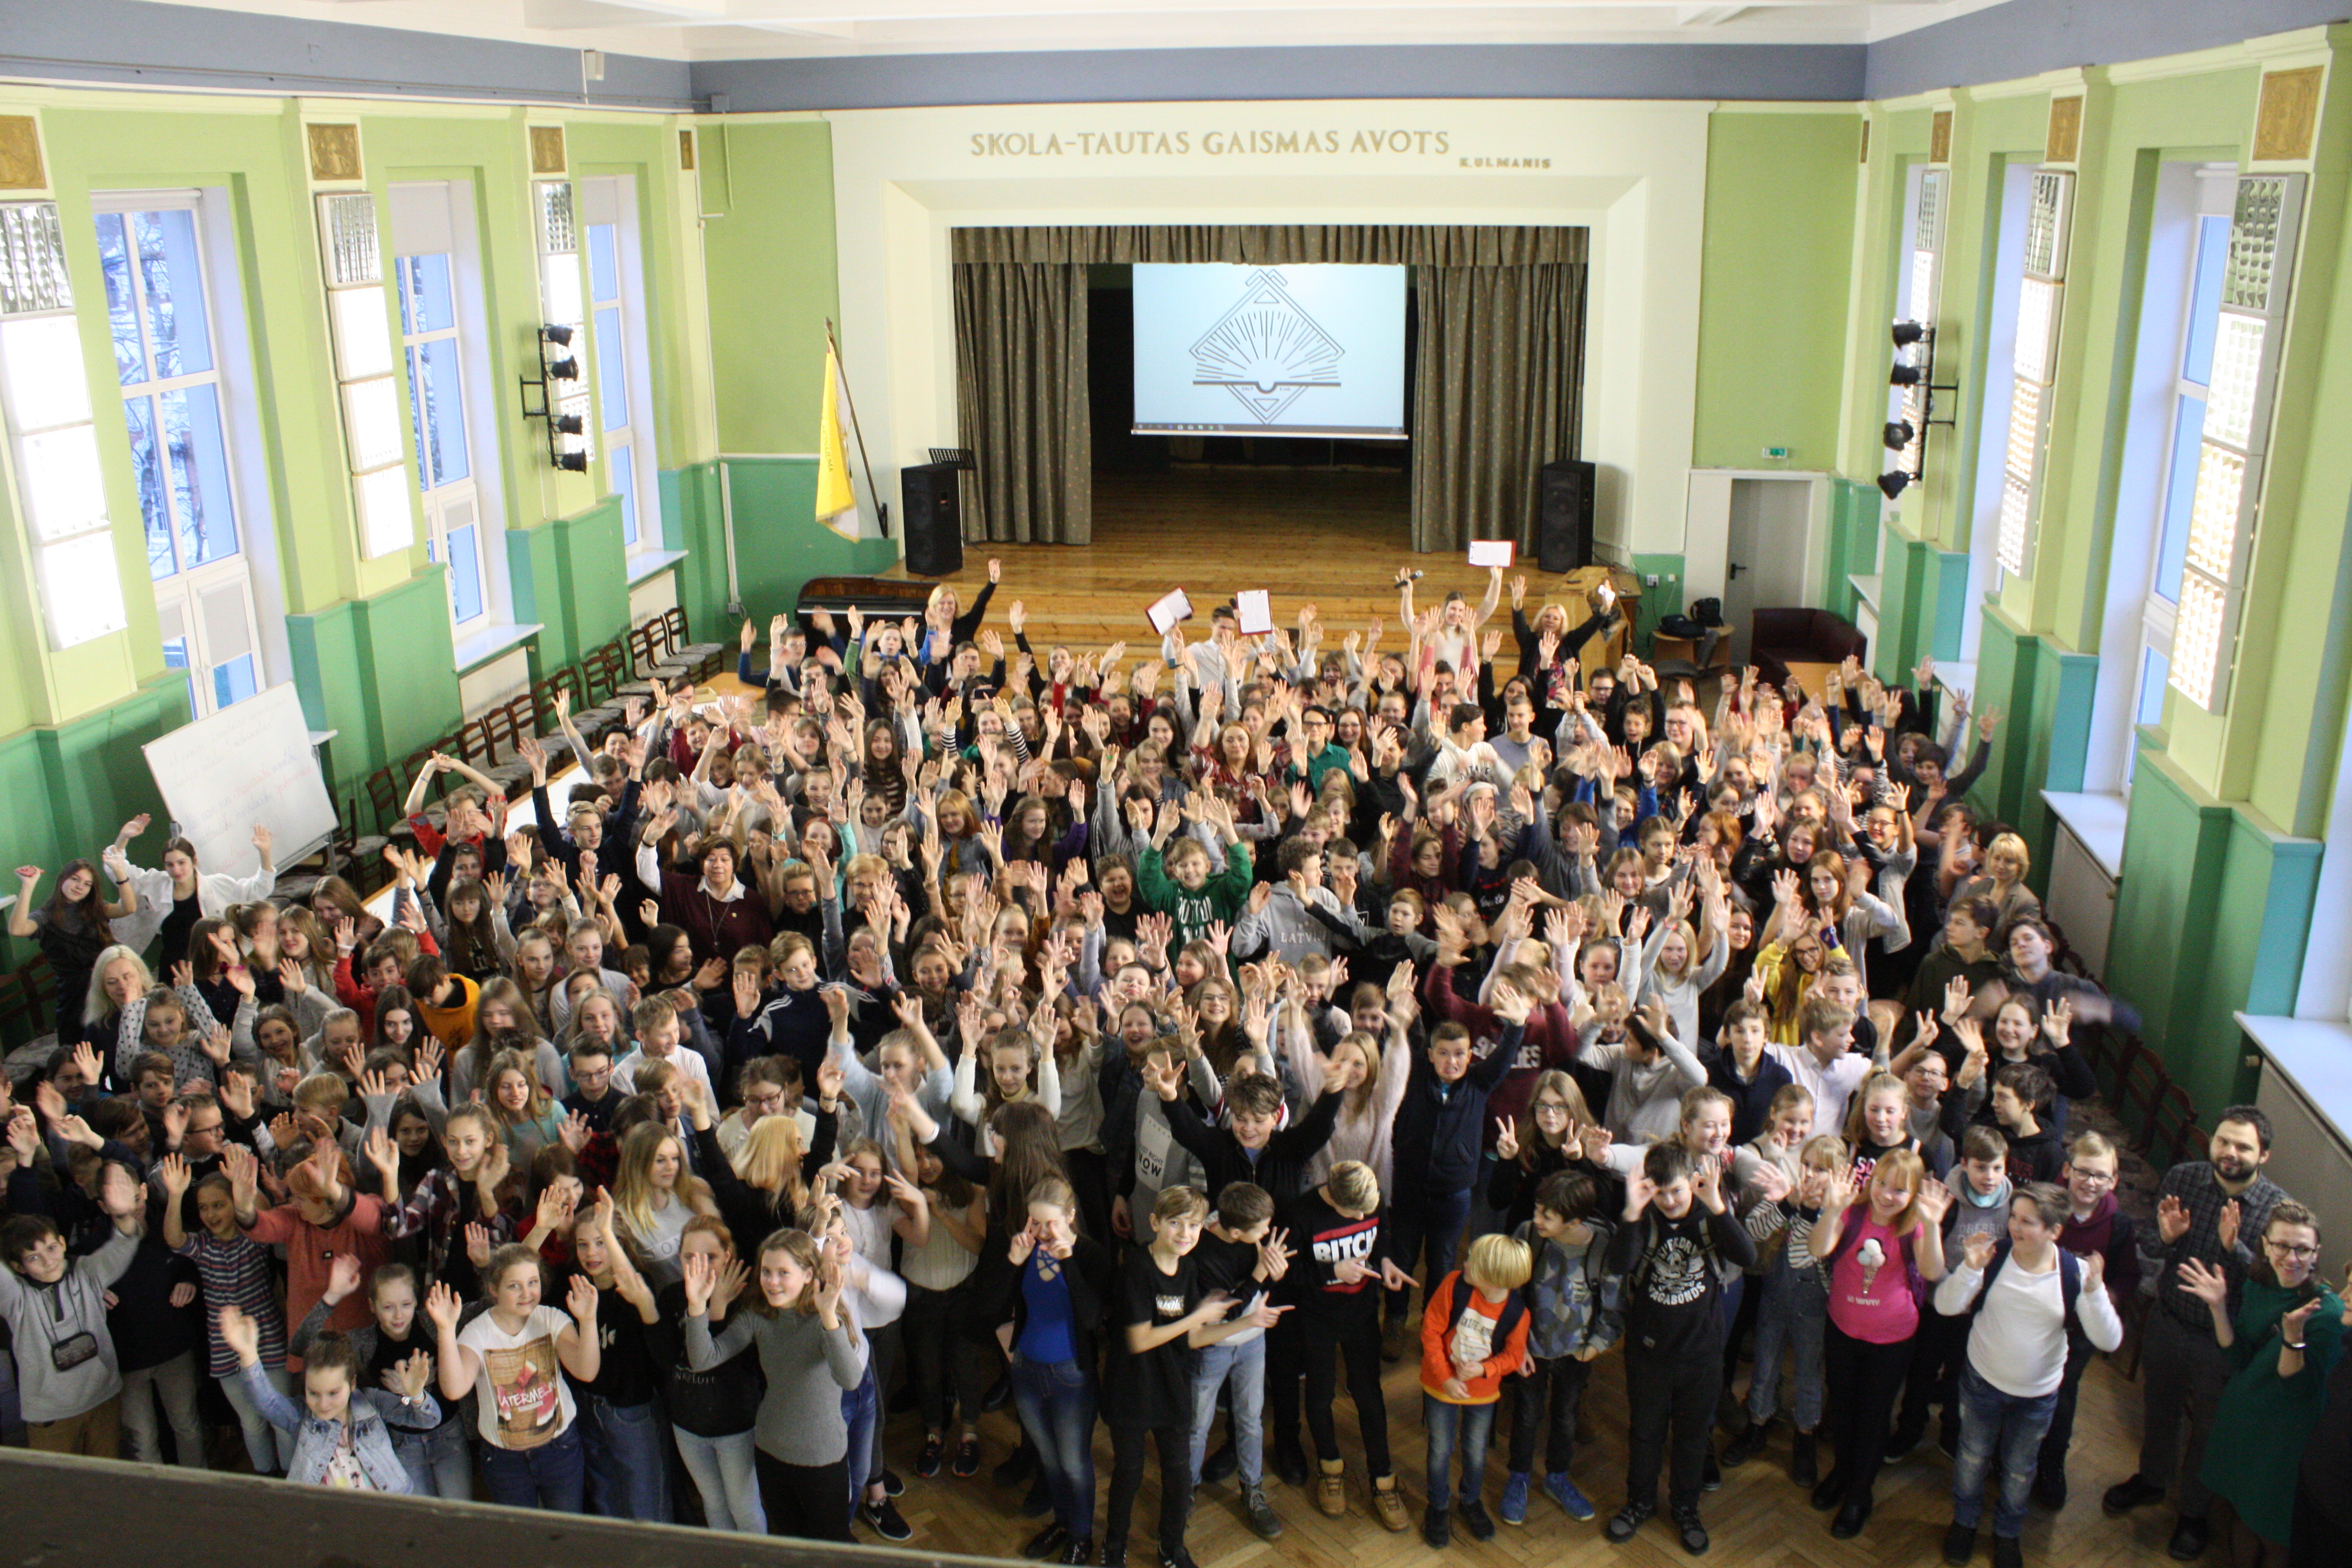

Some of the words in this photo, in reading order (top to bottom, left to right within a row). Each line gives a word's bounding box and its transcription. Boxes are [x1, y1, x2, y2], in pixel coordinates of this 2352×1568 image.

[971, 131, 1191, 156] SKOLA-TAUTAS
[1202, 130, 1340, 156] GAISMAS
[1350, 129, 1450, 155] AVOTS
[1139, 1151, 1162, 1177] NOW
[1648, 1282, 1706, 1305] VAGABONDS
